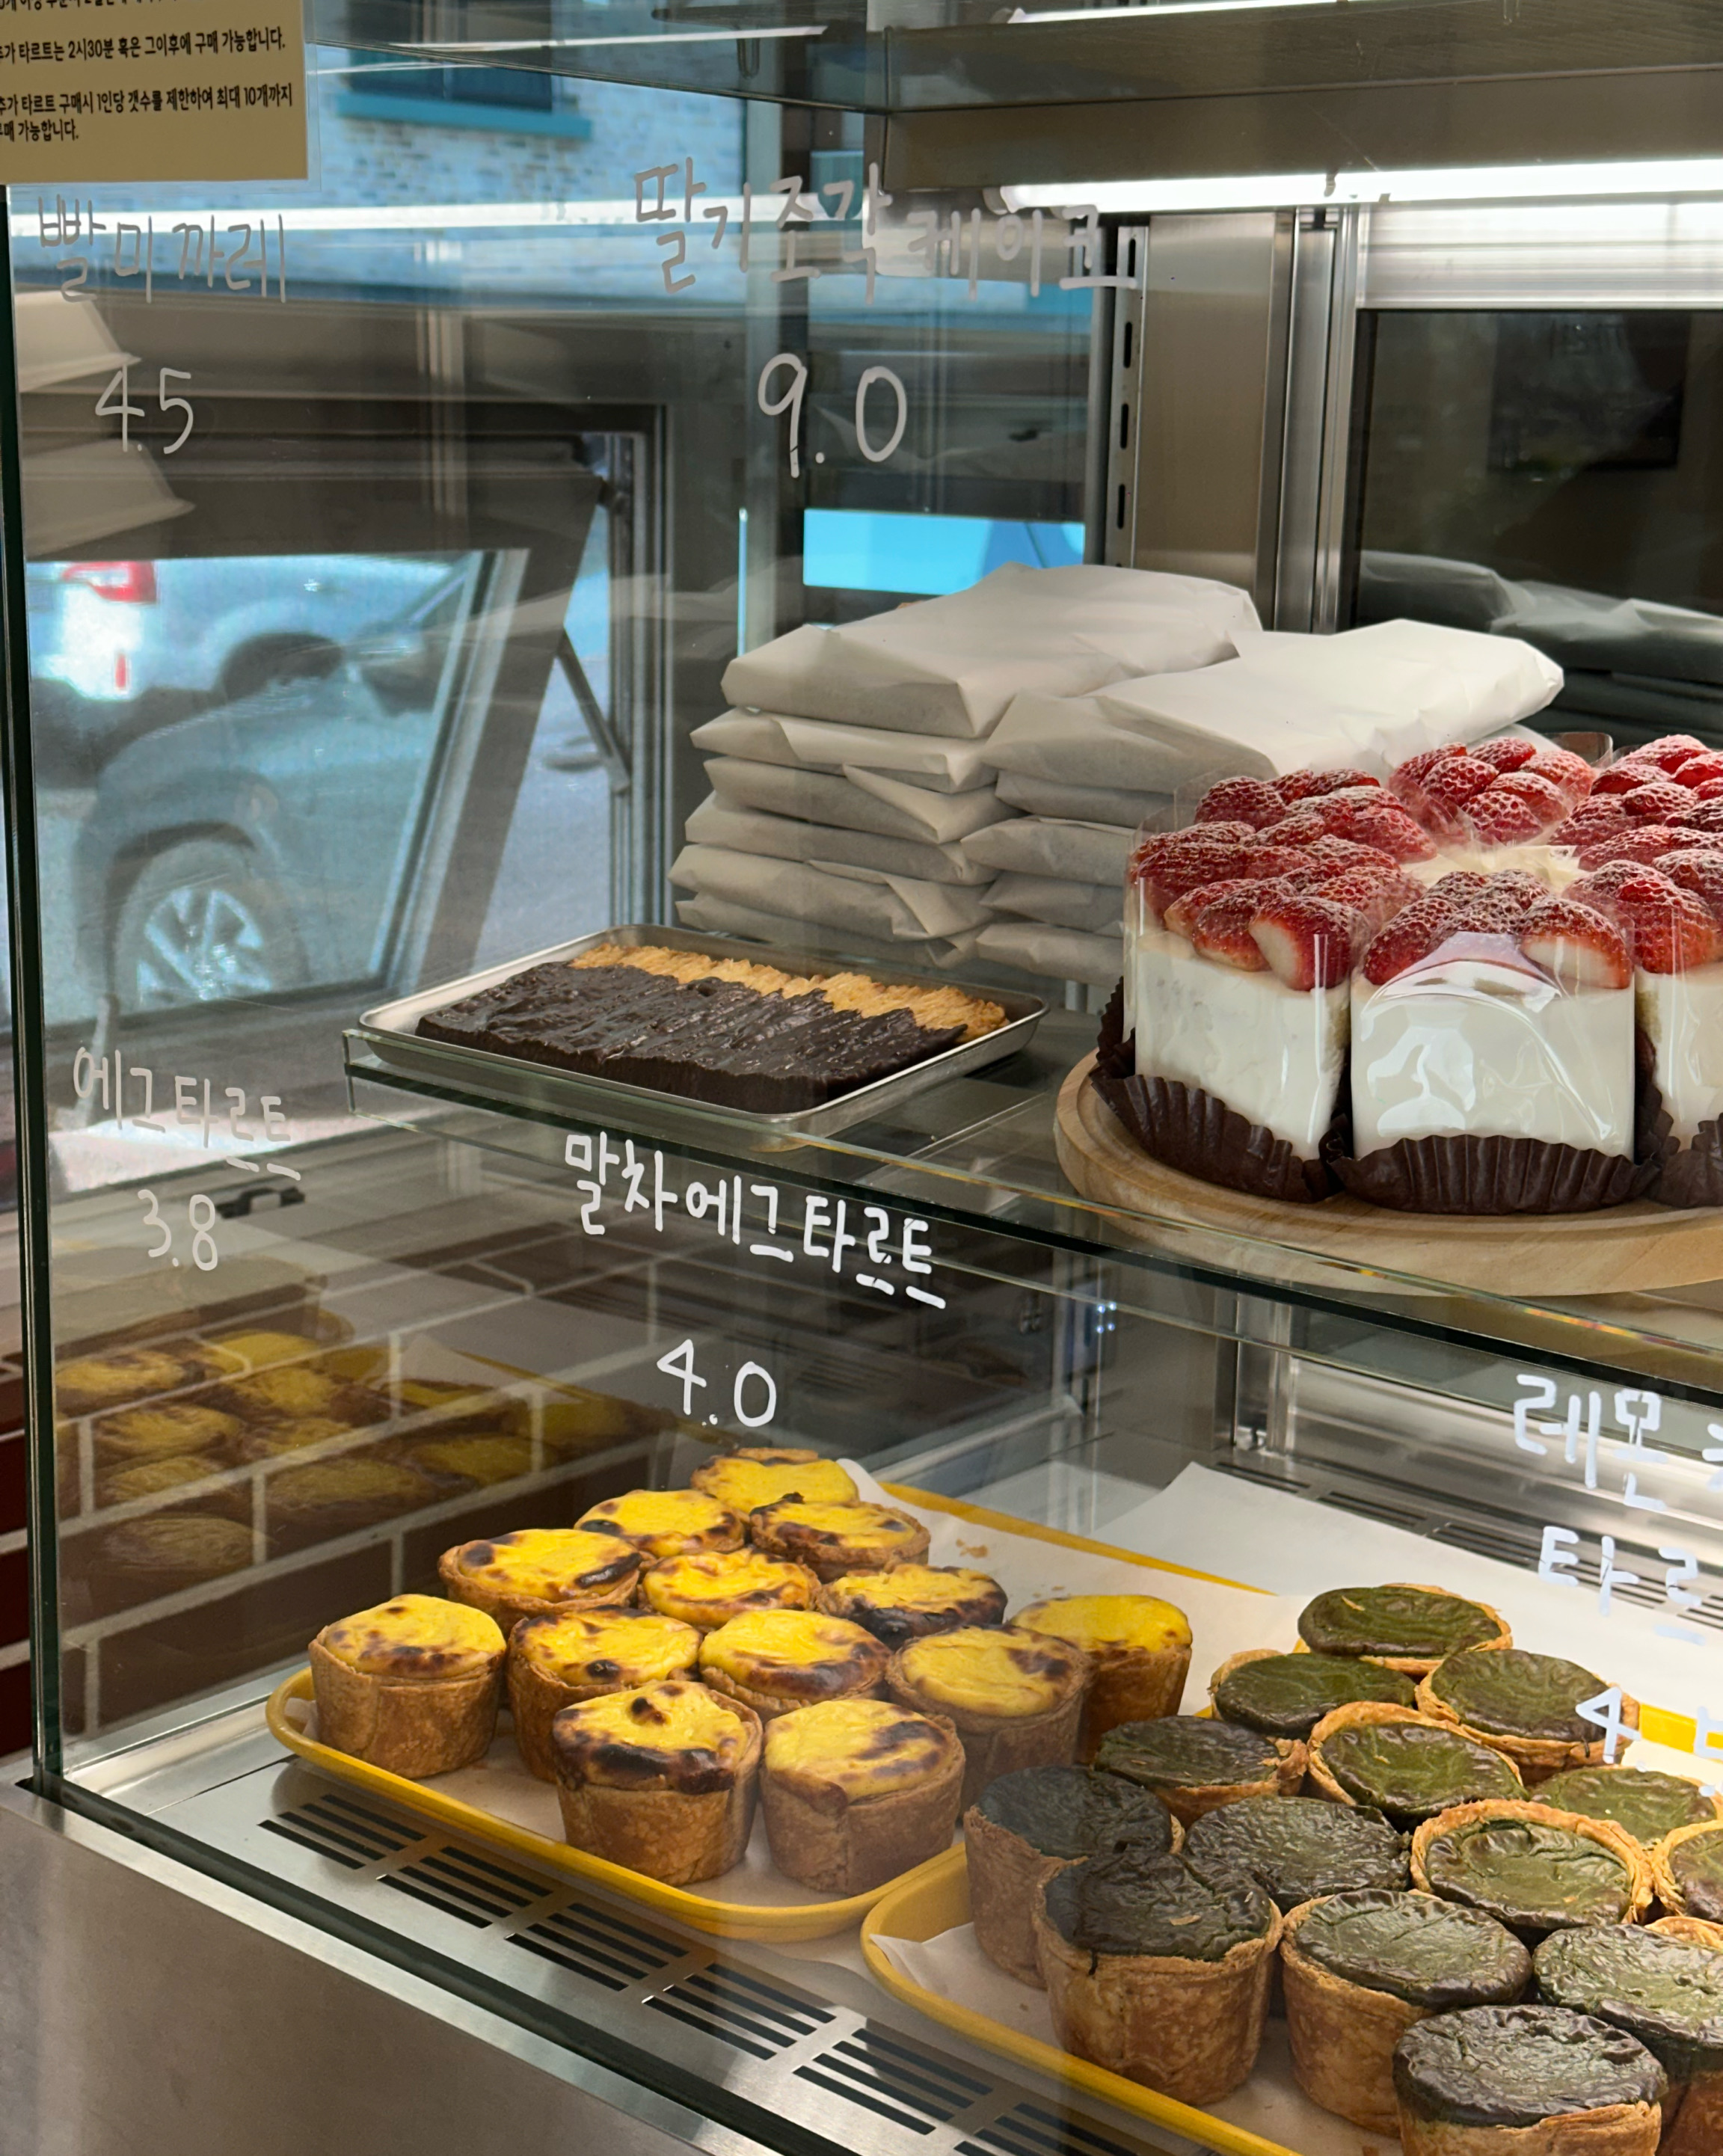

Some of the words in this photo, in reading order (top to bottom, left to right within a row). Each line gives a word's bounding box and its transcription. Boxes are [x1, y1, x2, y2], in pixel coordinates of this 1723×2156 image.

[19, 40, 65, 64] 타르트는
[68, 37, 114, 61] 2시30분
[117, 36, 141, 59] 혹은
[144, 31, 191, 58] 그이후에
[194, 30, 218, 54] 구매
[222, 25, 286, 52] 가능합니다.
[18, 117, 79, 142] 가능합니다.
[22, 93, 57, 117] 타르트
[59, 90, 93, 115] 구매시
[96, 89, 125, 114] 1인당
[128, 88, 163, 113] 갯수를
[166, 86, 213, 111] 제한하여
[216, 85, 240, 110] 최대
[243, 82, 293, 108] 10개까지
[38, 194, 286, 304] 빨미까레
[95, 363, 194, 455] 4.5
[758, 352, 908, 479] 9.0
[73, 1046, 301, 1181] 에그타르트
[138, 1189, 218, 1271] 3.8
[565, 1131, 947, 1309] 말차에그타르트
[657, 1339, 778, 1427] 4.0
